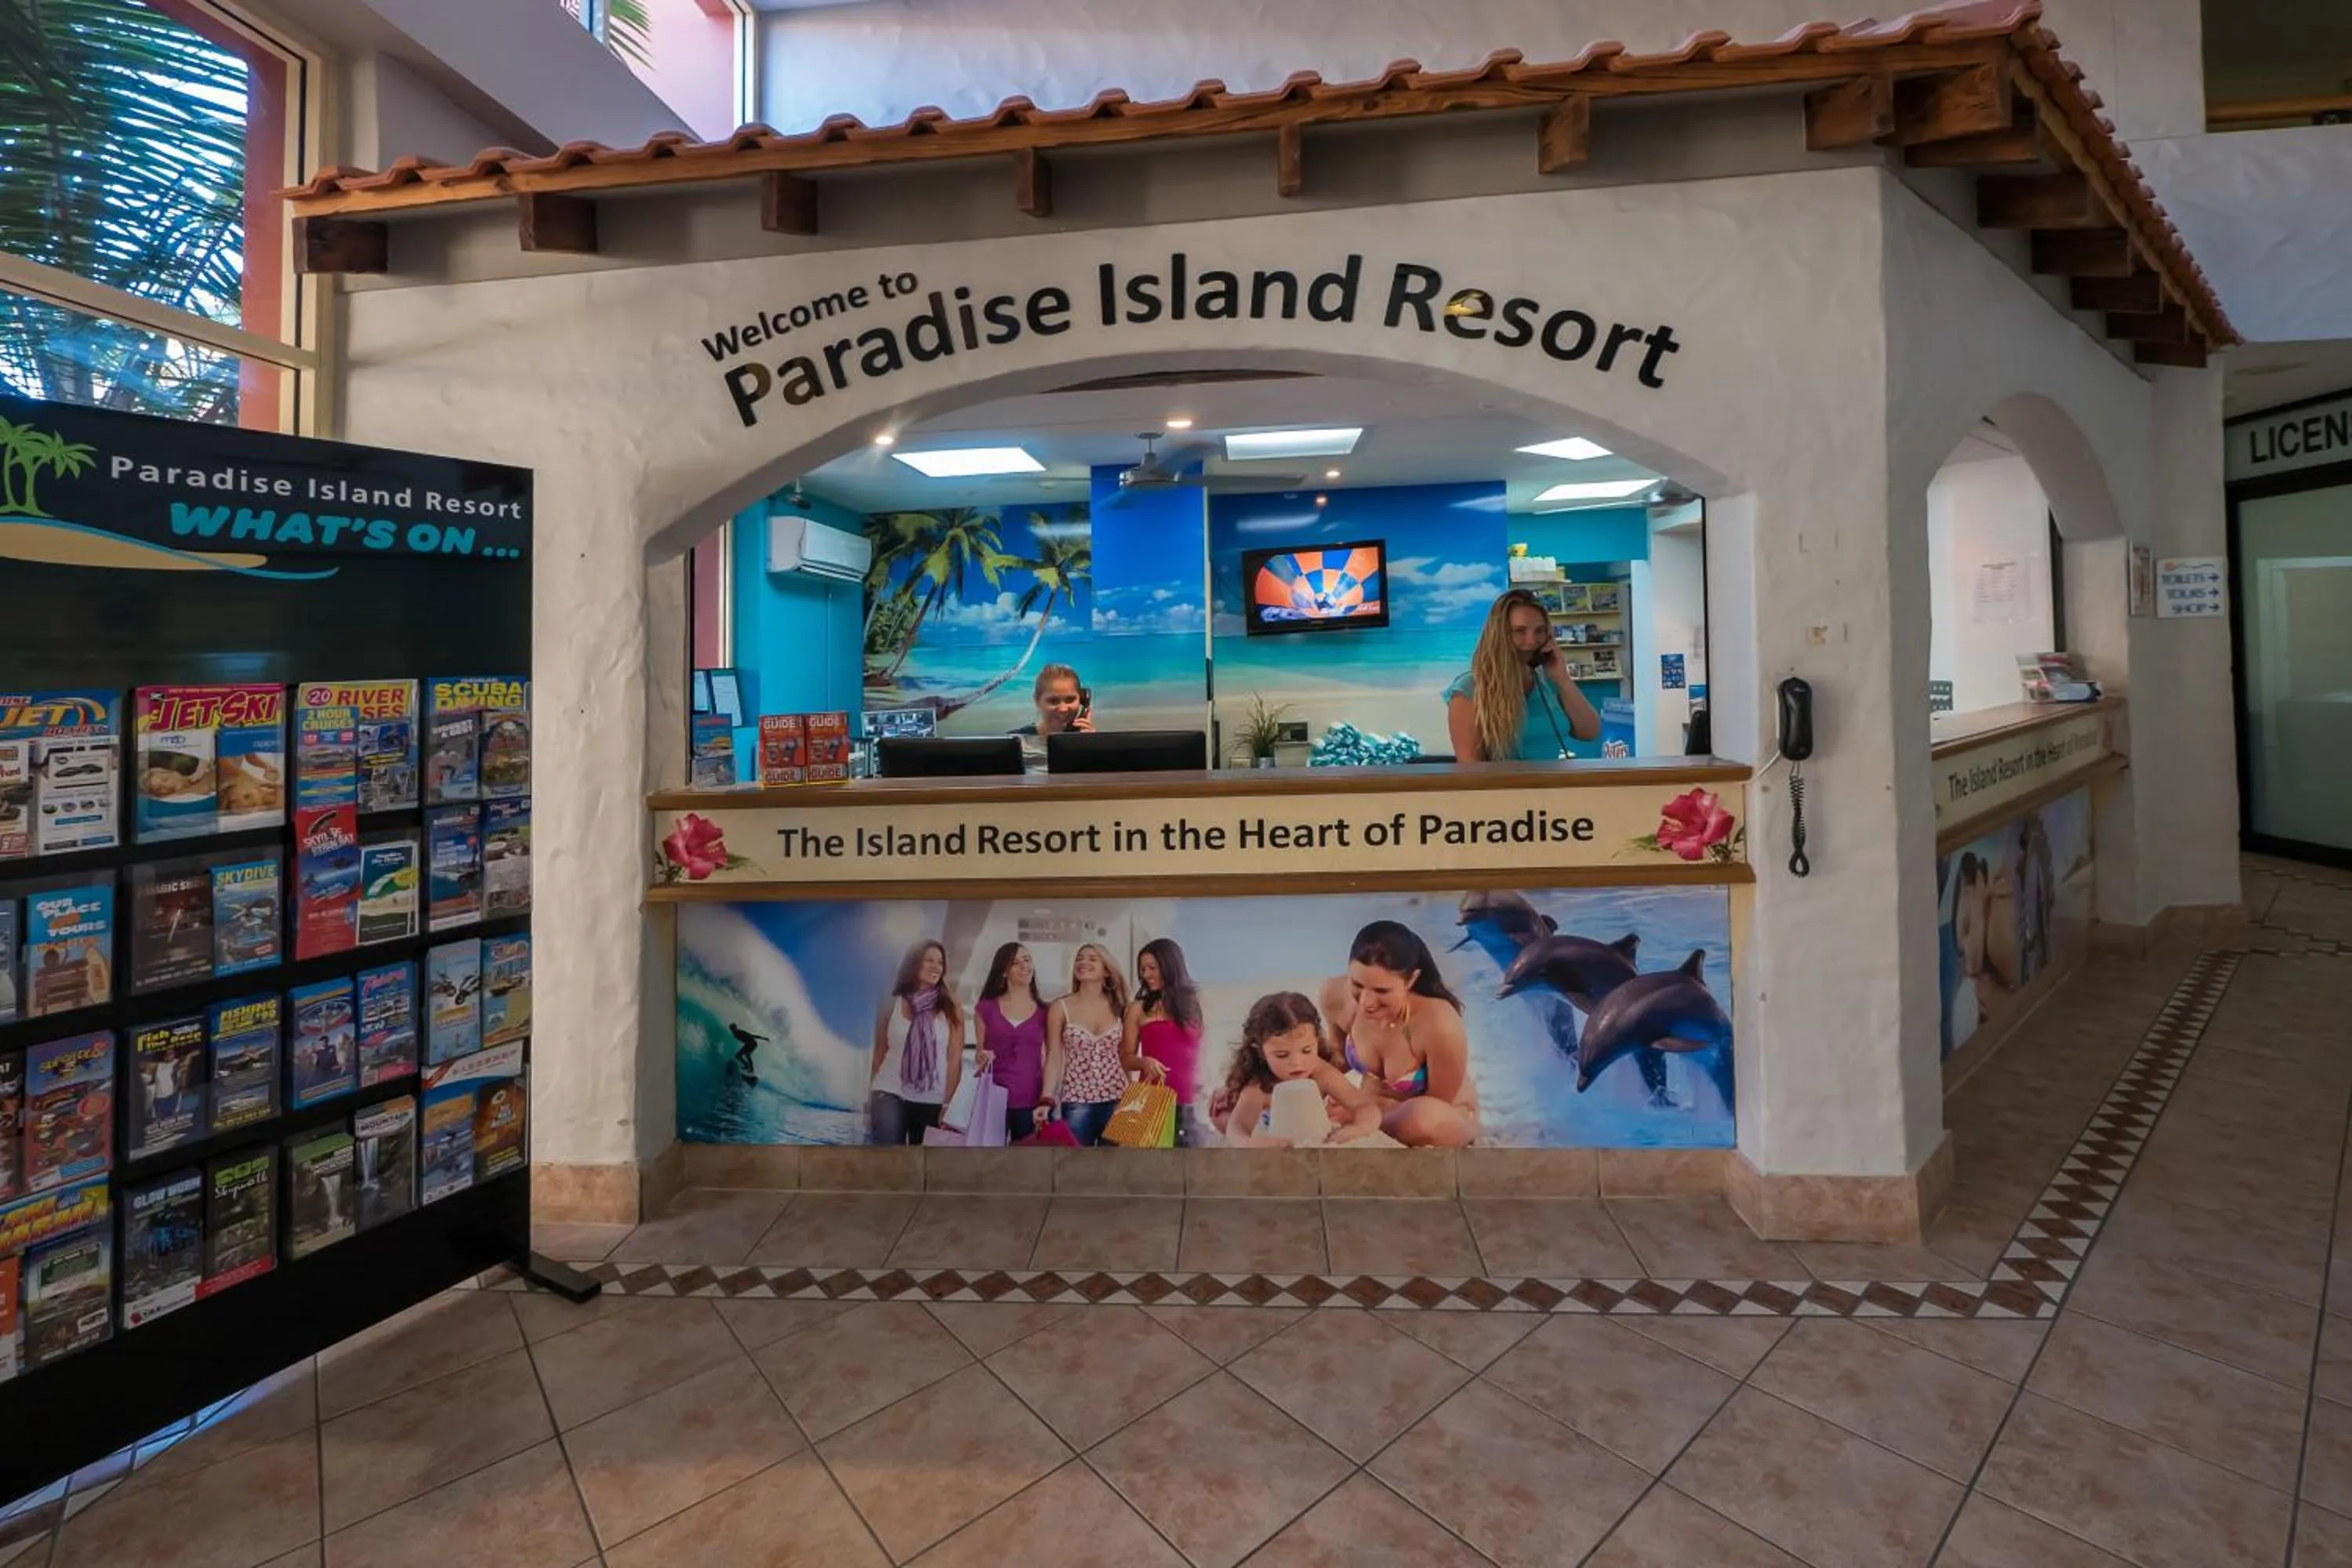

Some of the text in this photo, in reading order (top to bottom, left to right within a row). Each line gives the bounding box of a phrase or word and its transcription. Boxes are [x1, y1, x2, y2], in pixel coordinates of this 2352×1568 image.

[702, 271, 919, 362] Welcome to
[724, 252, 1680, 427] Paradise Island Resort
[2249, 410, 2352, 464] LICEN
[111, 456, 521, 519] Paradise Island Resort
[169, 503, 397, 550] WHAT'S
[407, 524, 475, 554] ON
[338, 688, 405, 706] RIVER
[434, 681, 523, 697] SCUBA
[435, 695, 522, 710] DIVING
[0, 705, 74, 728] JET
[764, 716, 797, 730] GUIDE
[1948, 771, 1969, 803] The
[1969, 761, 1998, 794] Island
[1998, 754, 2024, 782] Resort
[2024, 753, 2033, 773] in
[2034, 747, 2047, 769] the
[778, 810, 1595, 858] The Island Resort in the Heart of Paradise
[215, 864, 277, 886] SKYDIVE
[48, 920, 106, 937] TOURS
[132, 1186, 165, 1209] GLOW
